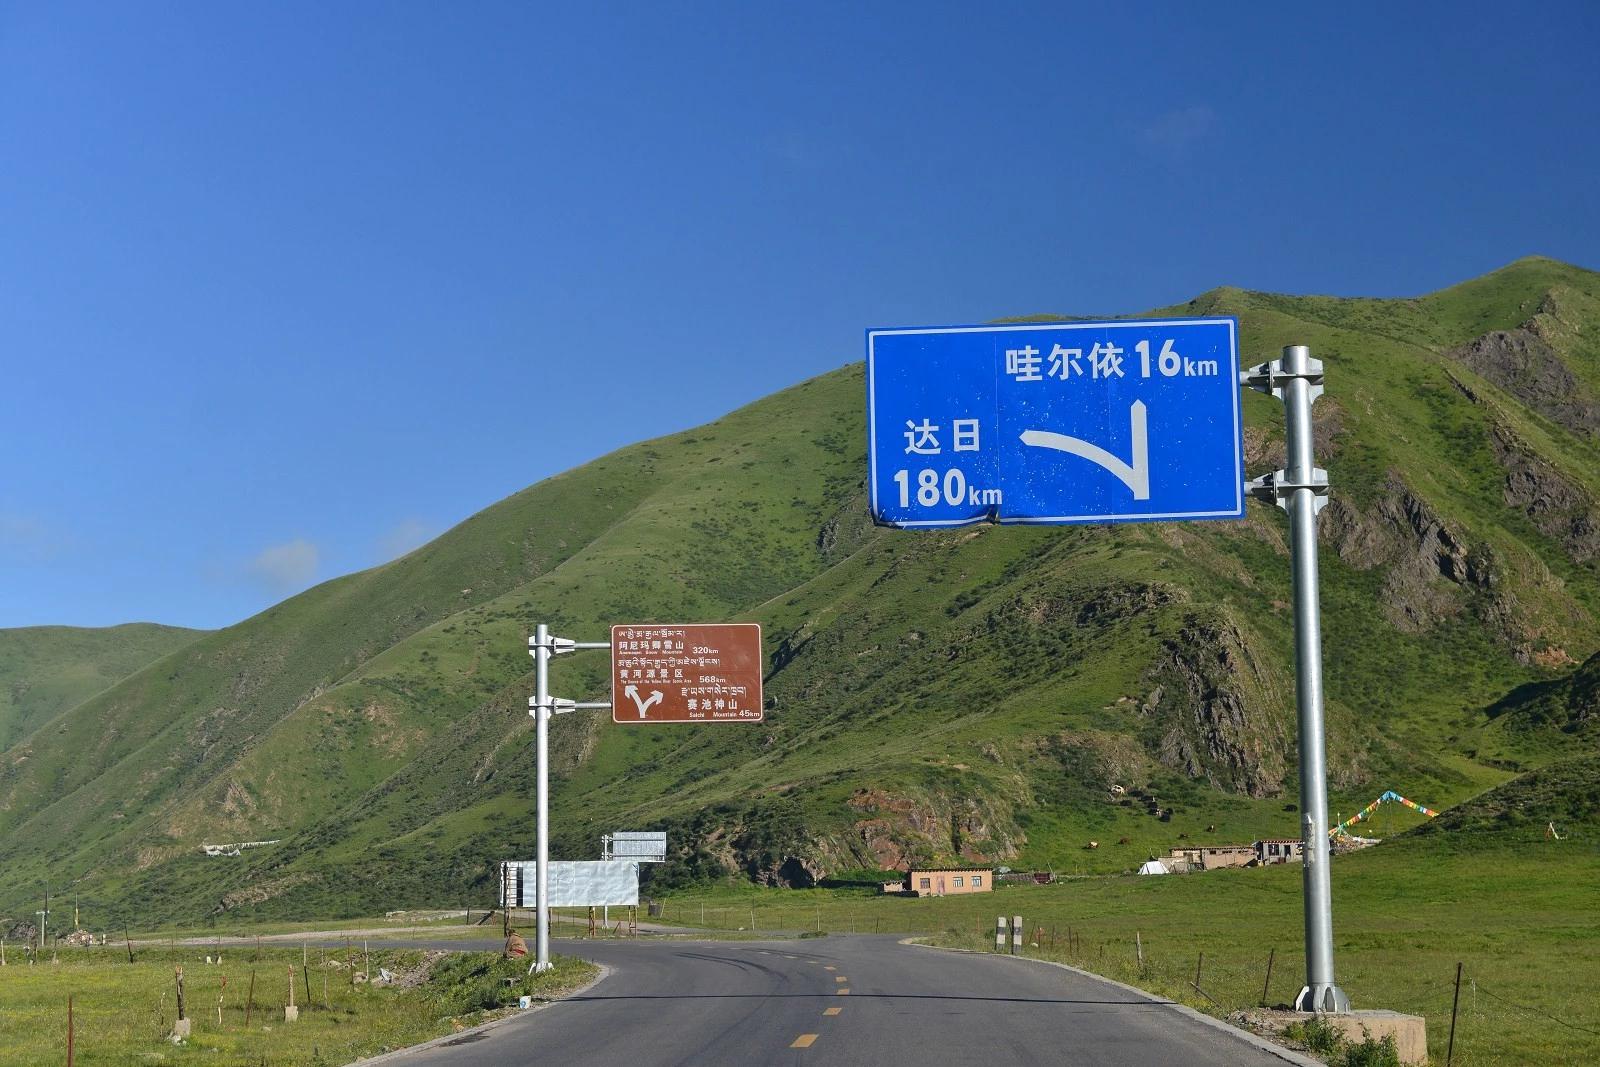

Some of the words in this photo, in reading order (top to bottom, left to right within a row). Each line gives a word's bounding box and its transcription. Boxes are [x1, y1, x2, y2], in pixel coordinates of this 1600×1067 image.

[1005, 342, 1125, 382] 哇尔依
[1134, 339, 1218, 378] 16km
[904, 418, 981, 455] 达日
[893, 468, 1003, 508] 180km
[692, 646, 719, 654] 320km
[699, 675, 726, 683] 568km
[738, 709, 760, 717] 45km
